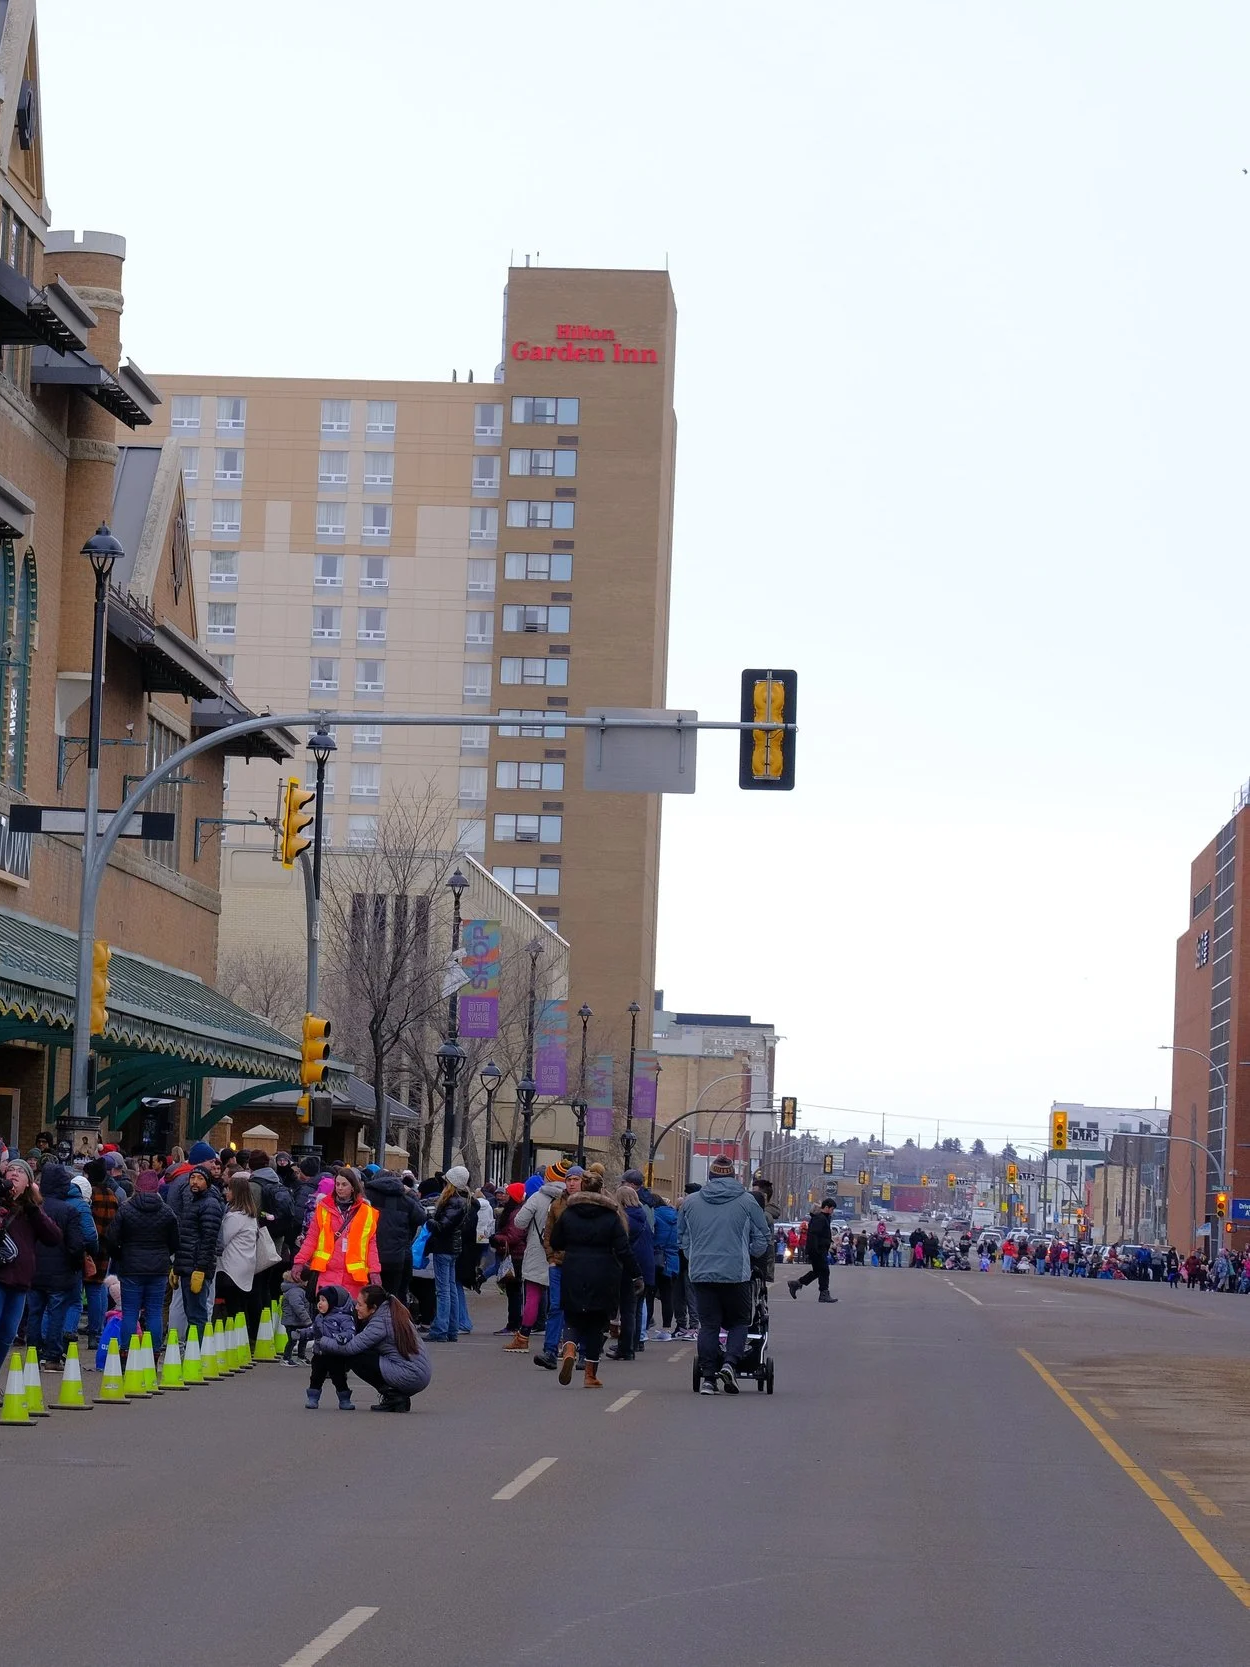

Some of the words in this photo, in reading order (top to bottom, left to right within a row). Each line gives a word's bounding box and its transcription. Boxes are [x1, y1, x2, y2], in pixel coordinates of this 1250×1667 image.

[556, 324, 615, 341] Hilton
[511, 341, 605, 363] Garden
[612, 343, 658, 364] Inn
[471, 926, 489, 990] SHOP
